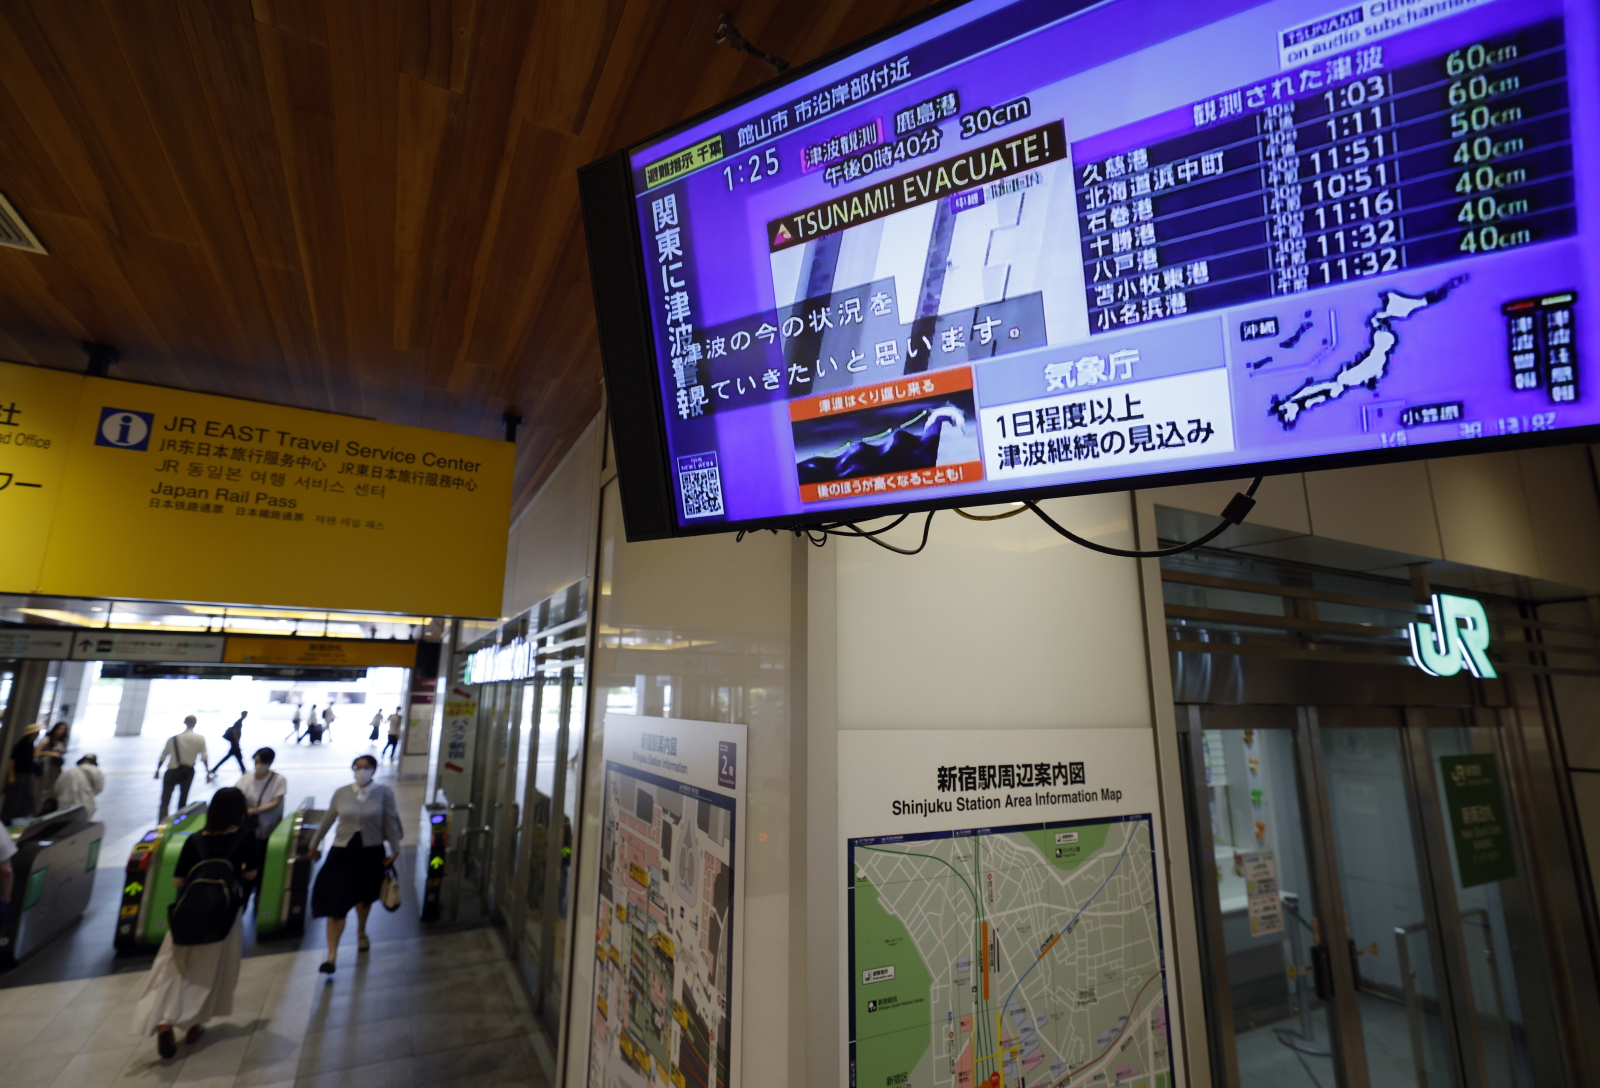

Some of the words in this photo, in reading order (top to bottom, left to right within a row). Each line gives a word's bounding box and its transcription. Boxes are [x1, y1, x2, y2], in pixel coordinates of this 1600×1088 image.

[738, 111, 788, 147] 館山市
[794, 56, 911, 123] 市沿岸部付近
[1193, 46, 1385, 128] 観測された津波
[1324, 76, 1385, 112] 1:03
[1446, 44, 1518, 76] 60cm
[897, 92, 957, 134] 鹿島港
[962, 100, 1028, 138] 30cm
[1085, 150, 1224, 210] 北海道浜中町
[1326, 106, 1382, 140] 1:11
[1448, 74, 1520, 106] 60cm
[723, 147, 779, 191] 1:25
[806, 122, 878, 168] 津波観測
[825, 128, 941, 186] 午後0時40分
[1087, 198, 1153, 233] 石巻港
[1310, 135, 1384, 174] 11:51
[1451, 106, 1522, 138] 50cm
[793, 183, 896, 240] TSUNAMI!
[903, 130, 1050, 203] EVACUATE!
[1090, 223, 1156, 257] 十勝港
[1313, 163, 1386, 201] 10:51
[1453, 136, 1524, 163] 40cm
[1093, 248, 1158, 282] 八戸港
[1315, 190, 1394, 230] 11:16
[1455, 166, 1526, 193] 40cm
[1317, 219, 1396, 257] 11:32
[1458, 196, 1528, 222] 40cm
[1098, 292, 1187, 330] 小名浜港
[1319, 248, 1399, 284] 11:32
[1460, 226, 1530, 253] 40cm
[1044, 349, 1140, 392] 気象庁
[163, 416, 197, 434] JR
[204, 420, 270, 443] EAST
[276, 430, 339, 454] Travel
[345, 441, 416, 464] Service
[422, 452, 482, 473] Center
[996, 393, 1144, 439] 1日程度以上
[997, 418, 1215, 470] 津波継続の見込み
[155, 459, 180, 473] JR
[186, 461, 243, 482] 동일본
[250, 470, 286, 488] 여행
[294, 475, 345, 493] 서비스
[354, 482, 386, 498] 센터
[159, 438, 327, 472] JR东日本旅行服务中心
[338, 461, 478, 492] JR東日本旅行服務中心
[151, 481, 209, 500] Japan
[215, 488, 250, 503] Rail
[255, 492, 298, 509] Pass
[1409, 593, 1498, 678] JR
[648, 755, 662, 768] Station
[662, 759, 688, 775] Information
[937, 762, 1086, 792] 新宿駅周辺案内図
[892, 799, 953, 818] Shinjuku
[956, 796, 1001, 812] Station
[1005, 793, 1032, 808] Area
[1035, 789, 1098, 806] Information
[1101, 788, 1122, 803] Map
